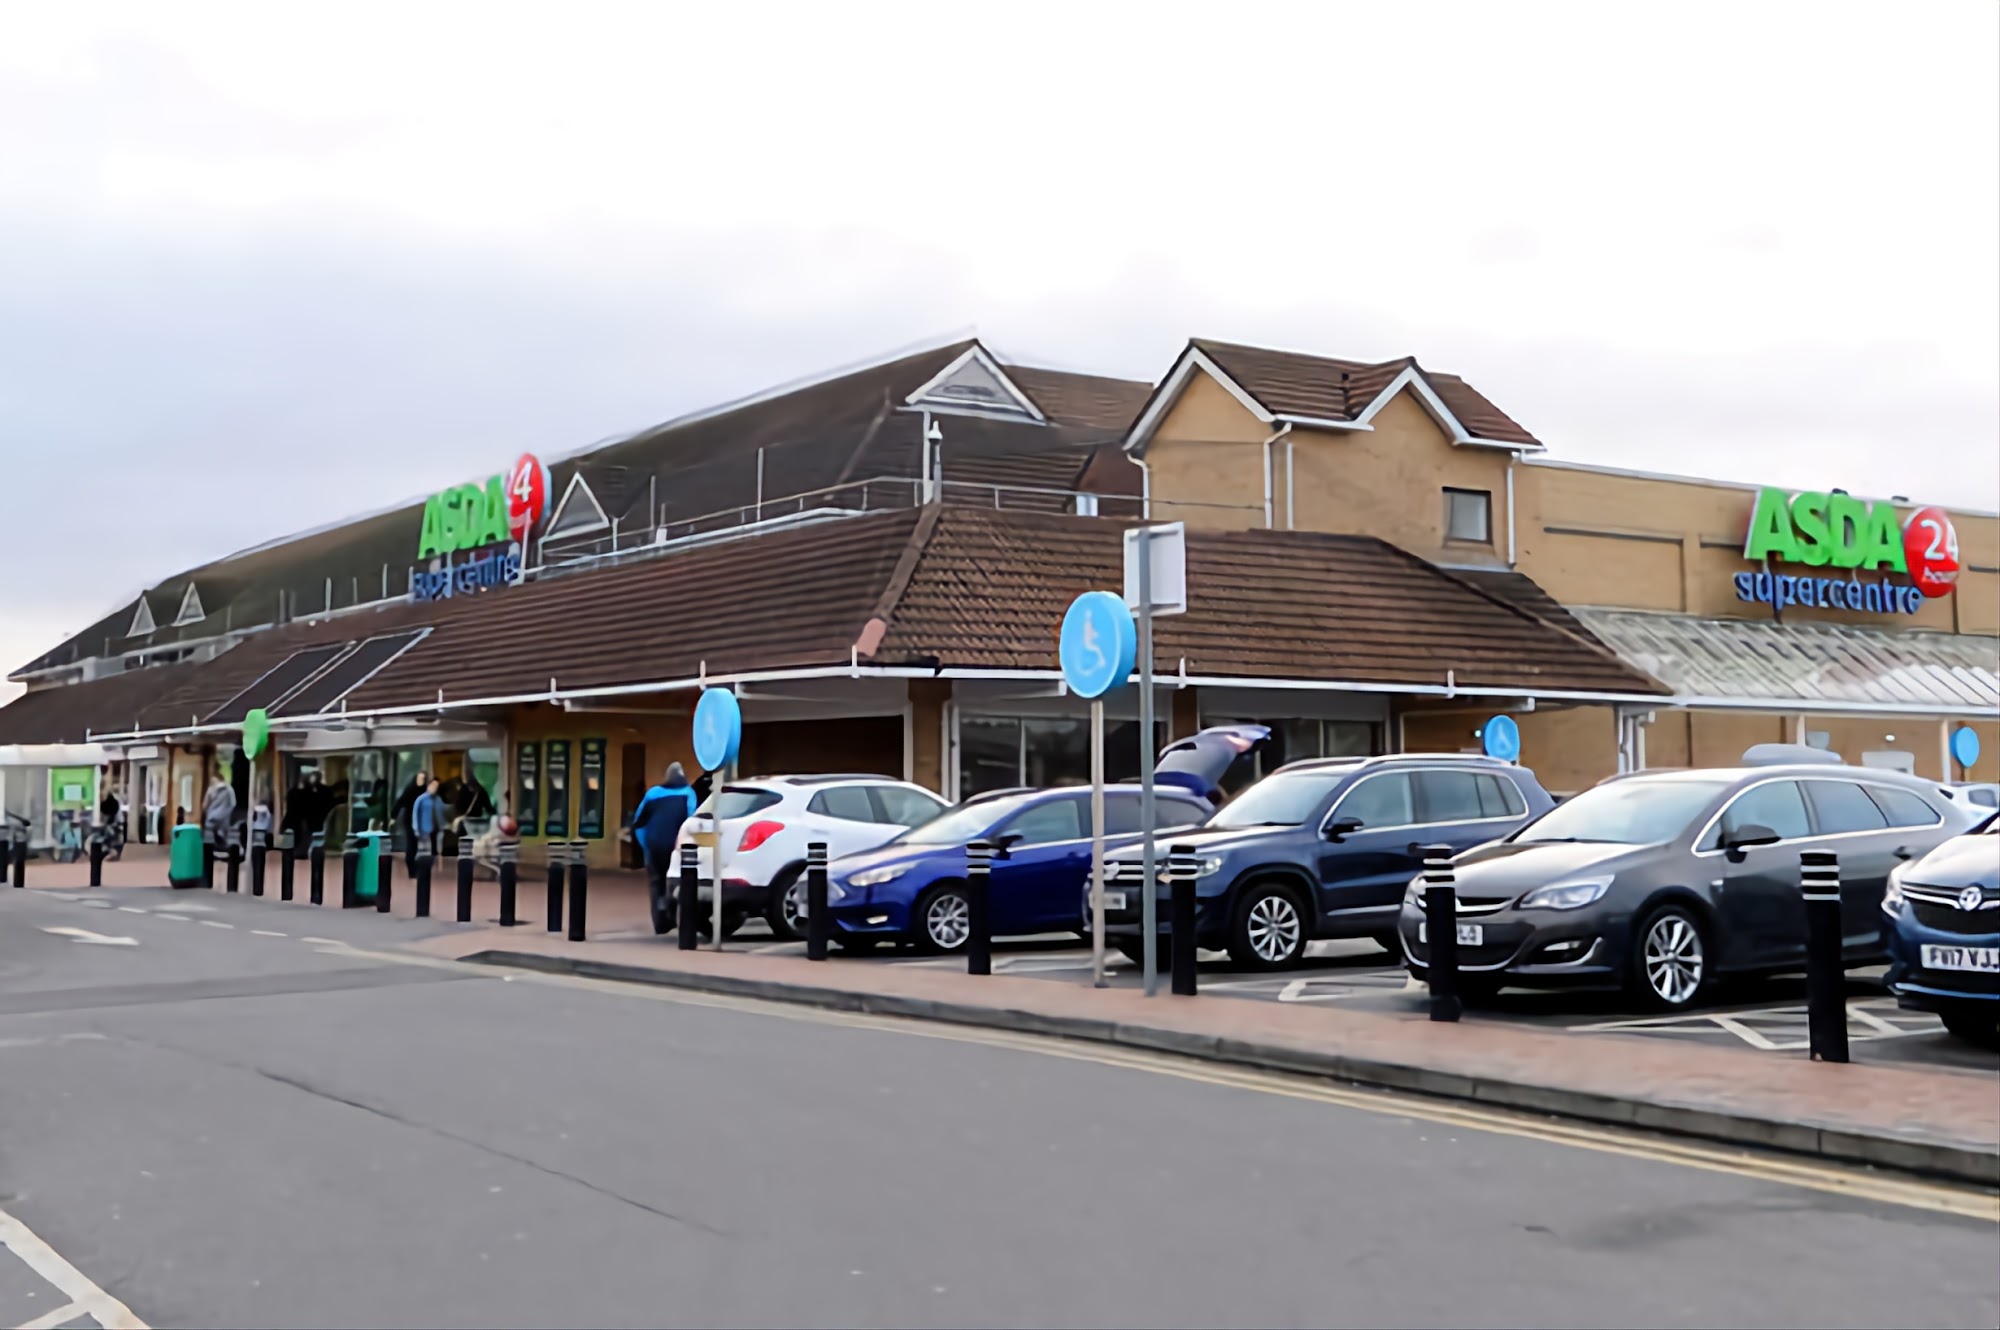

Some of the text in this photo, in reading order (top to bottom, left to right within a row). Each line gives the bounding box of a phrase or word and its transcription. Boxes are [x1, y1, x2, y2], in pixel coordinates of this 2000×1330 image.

[418, 474, 510, 560] ASDA
[1744, 486, 1908, 573] ASDA
[1733, 571, 1925, 615] supercentre
